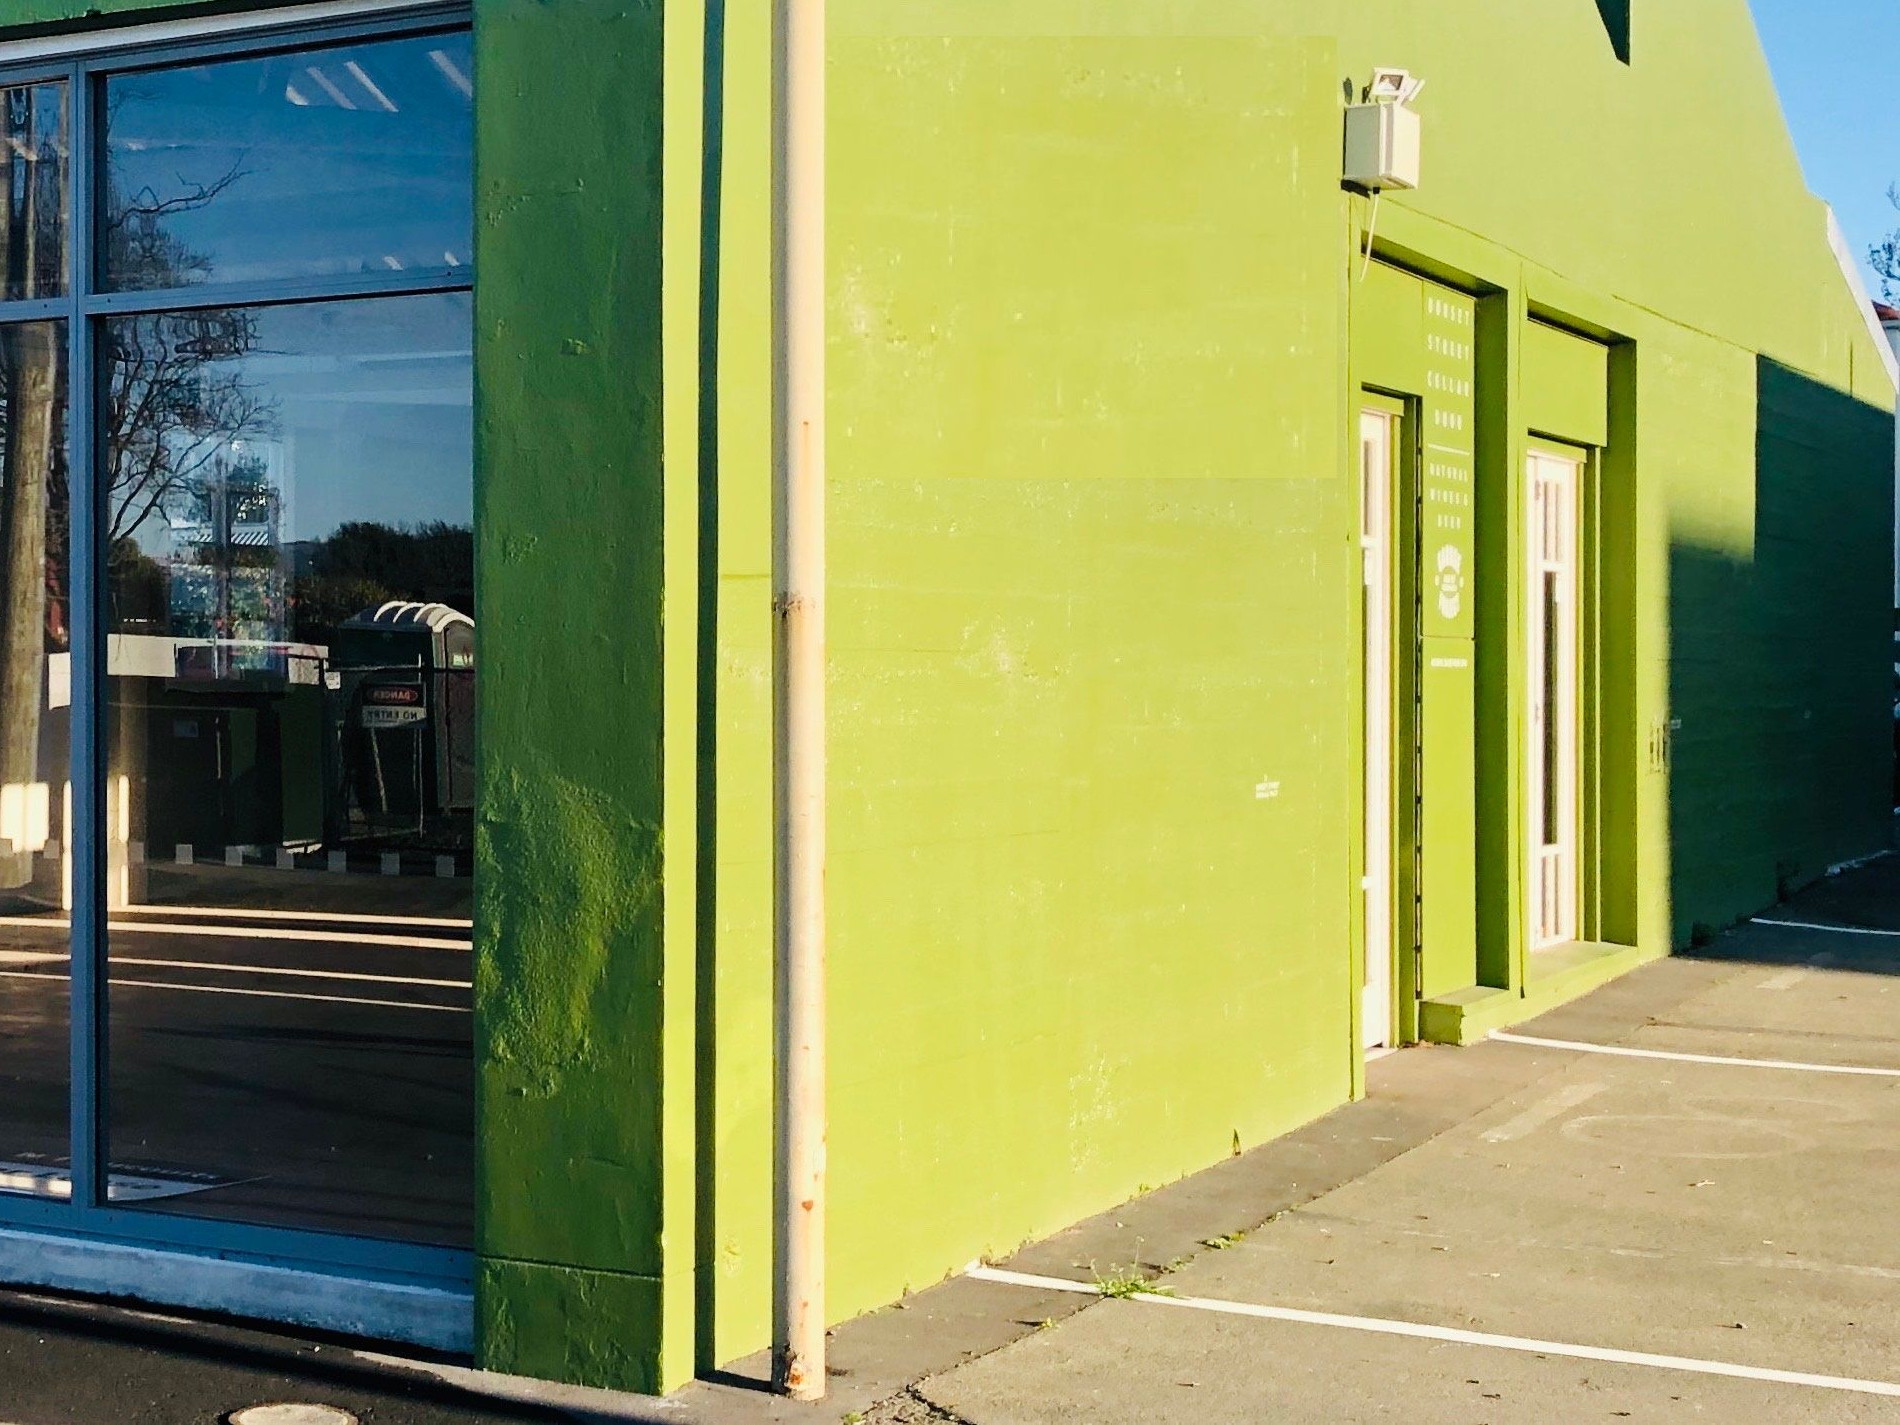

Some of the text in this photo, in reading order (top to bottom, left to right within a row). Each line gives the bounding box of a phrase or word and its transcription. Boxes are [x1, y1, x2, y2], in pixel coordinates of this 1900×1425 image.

[1427, 297, 1470, 326] DORSET
[1427, 334, 1470, 362] STREET
[1427, 370, 1470, 397] CELLAR
